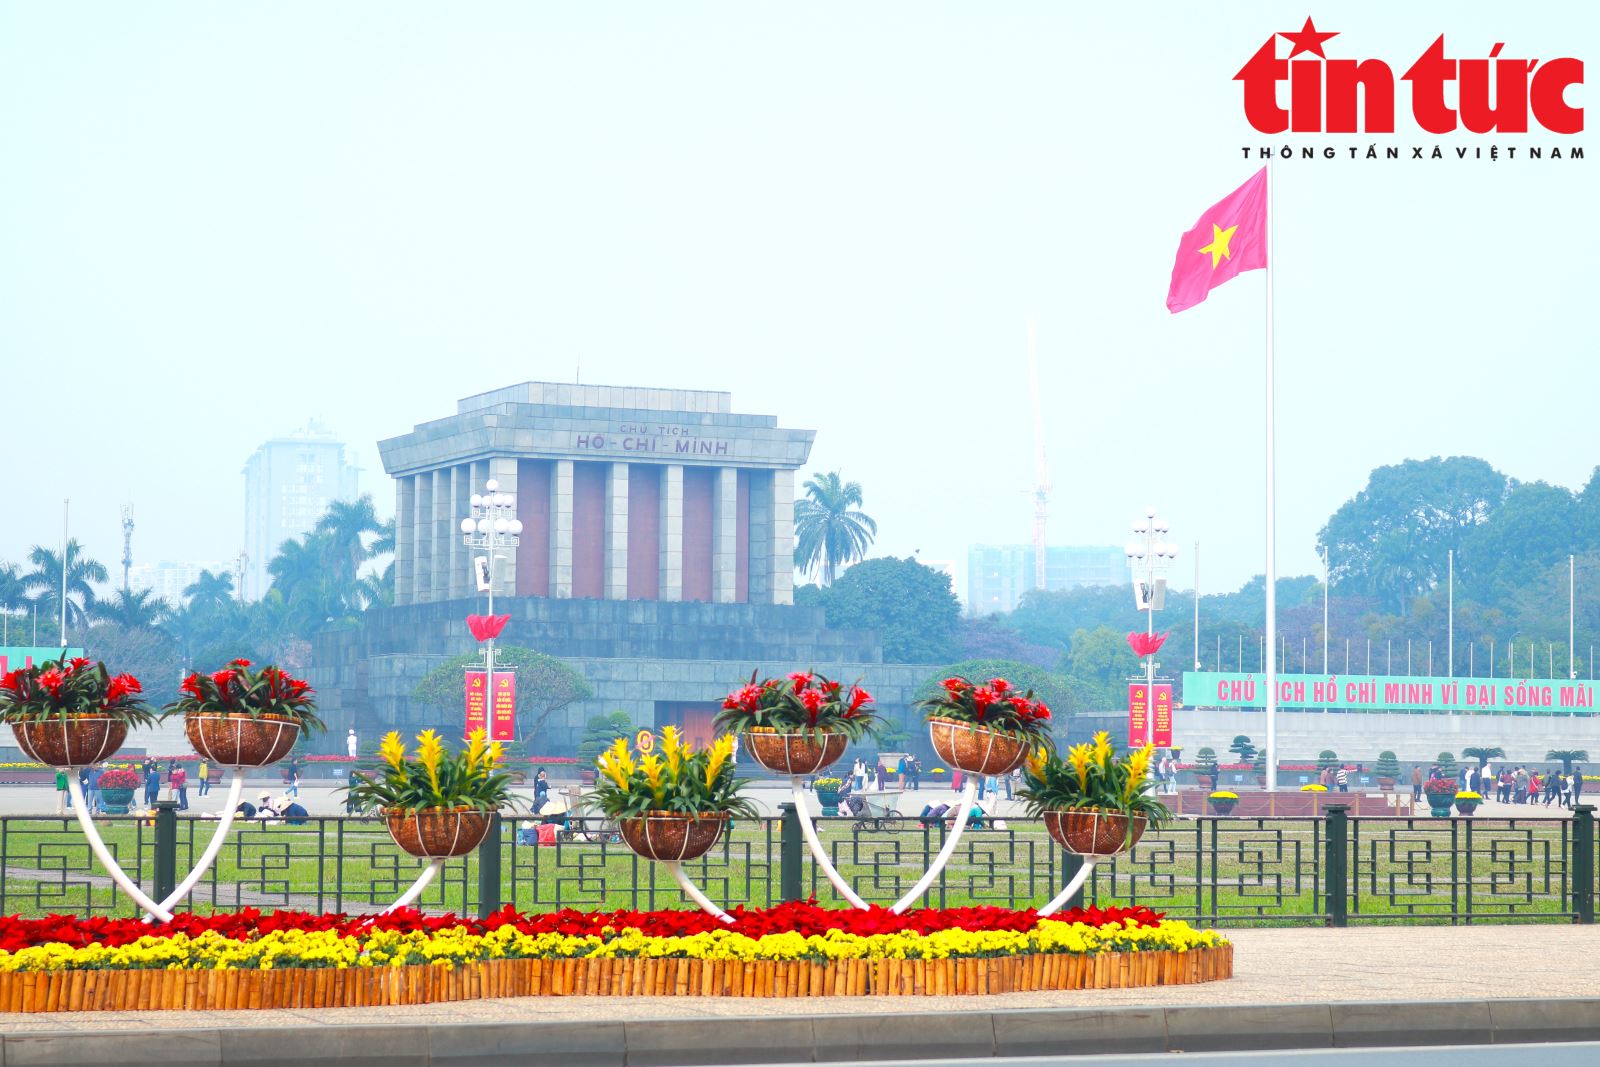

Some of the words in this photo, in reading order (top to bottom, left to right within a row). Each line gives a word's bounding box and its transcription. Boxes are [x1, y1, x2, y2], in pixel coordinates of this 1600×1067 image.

[1217, 674, 1255, 702] CHỦ
[1313, 675, 1337, 703] HỒ
[1345, 678, 1376, 703] CHÍ
[1384, 683, 1433, 705] MINH
[1441, 681, 1458, 705] VĨ
[1466, 684, 1496, 709] ĐẠI
[1504, 680, 1553, 707] SỐNG
[1559, 684, 1593, 708] MÃI
